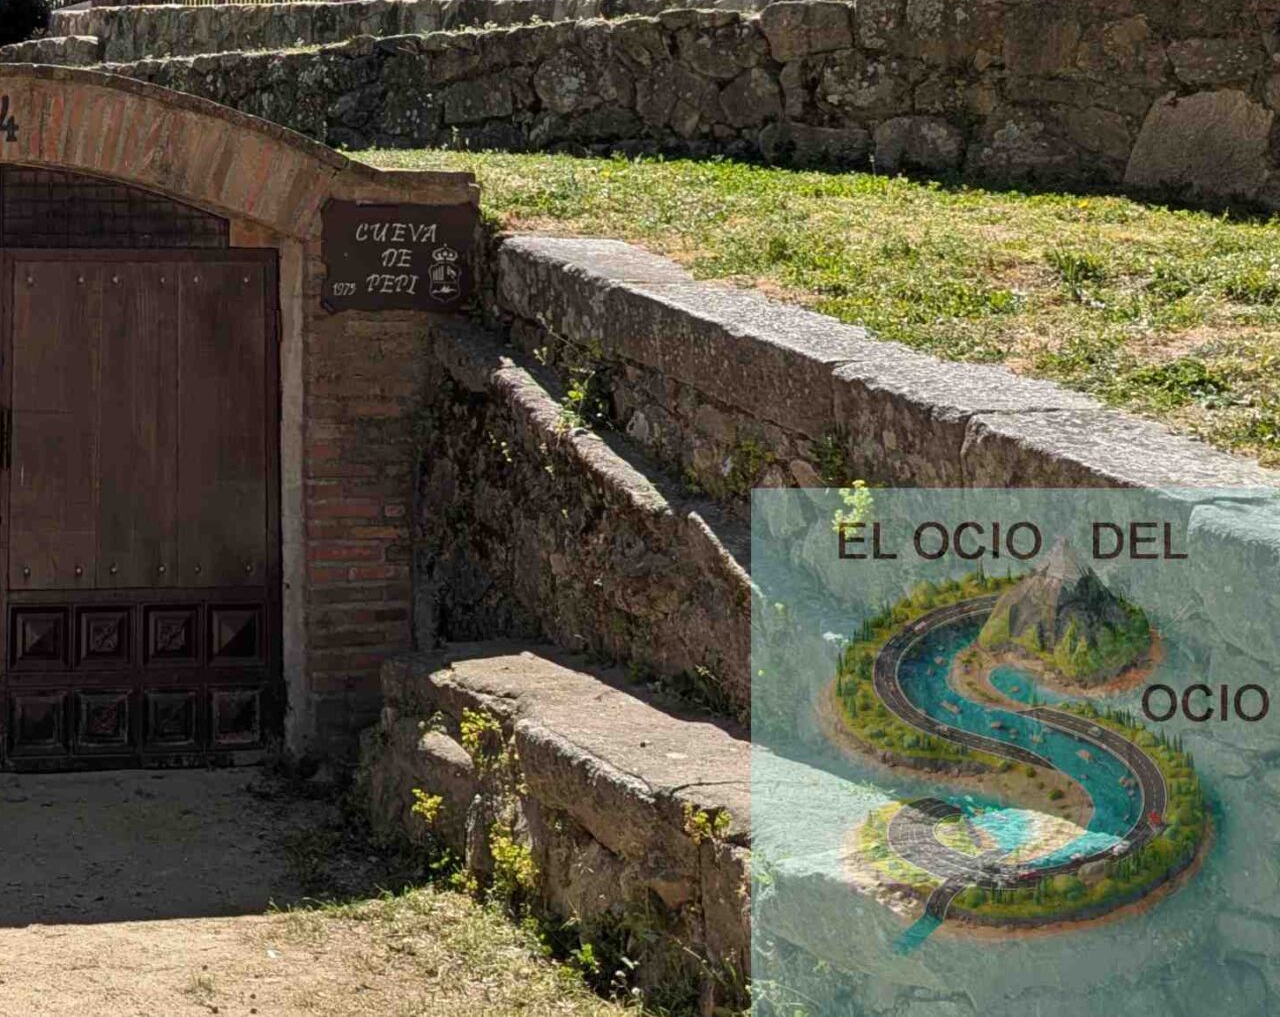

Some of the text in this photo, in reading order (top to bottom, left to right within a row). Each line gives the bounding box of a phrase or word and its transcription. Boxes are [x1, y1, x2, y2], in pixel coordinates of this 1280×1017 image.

[355, 223, 438, 243] CUEVA
[381, 248, 412, 267] DE
[366, 273, 419, 295] PEPI
